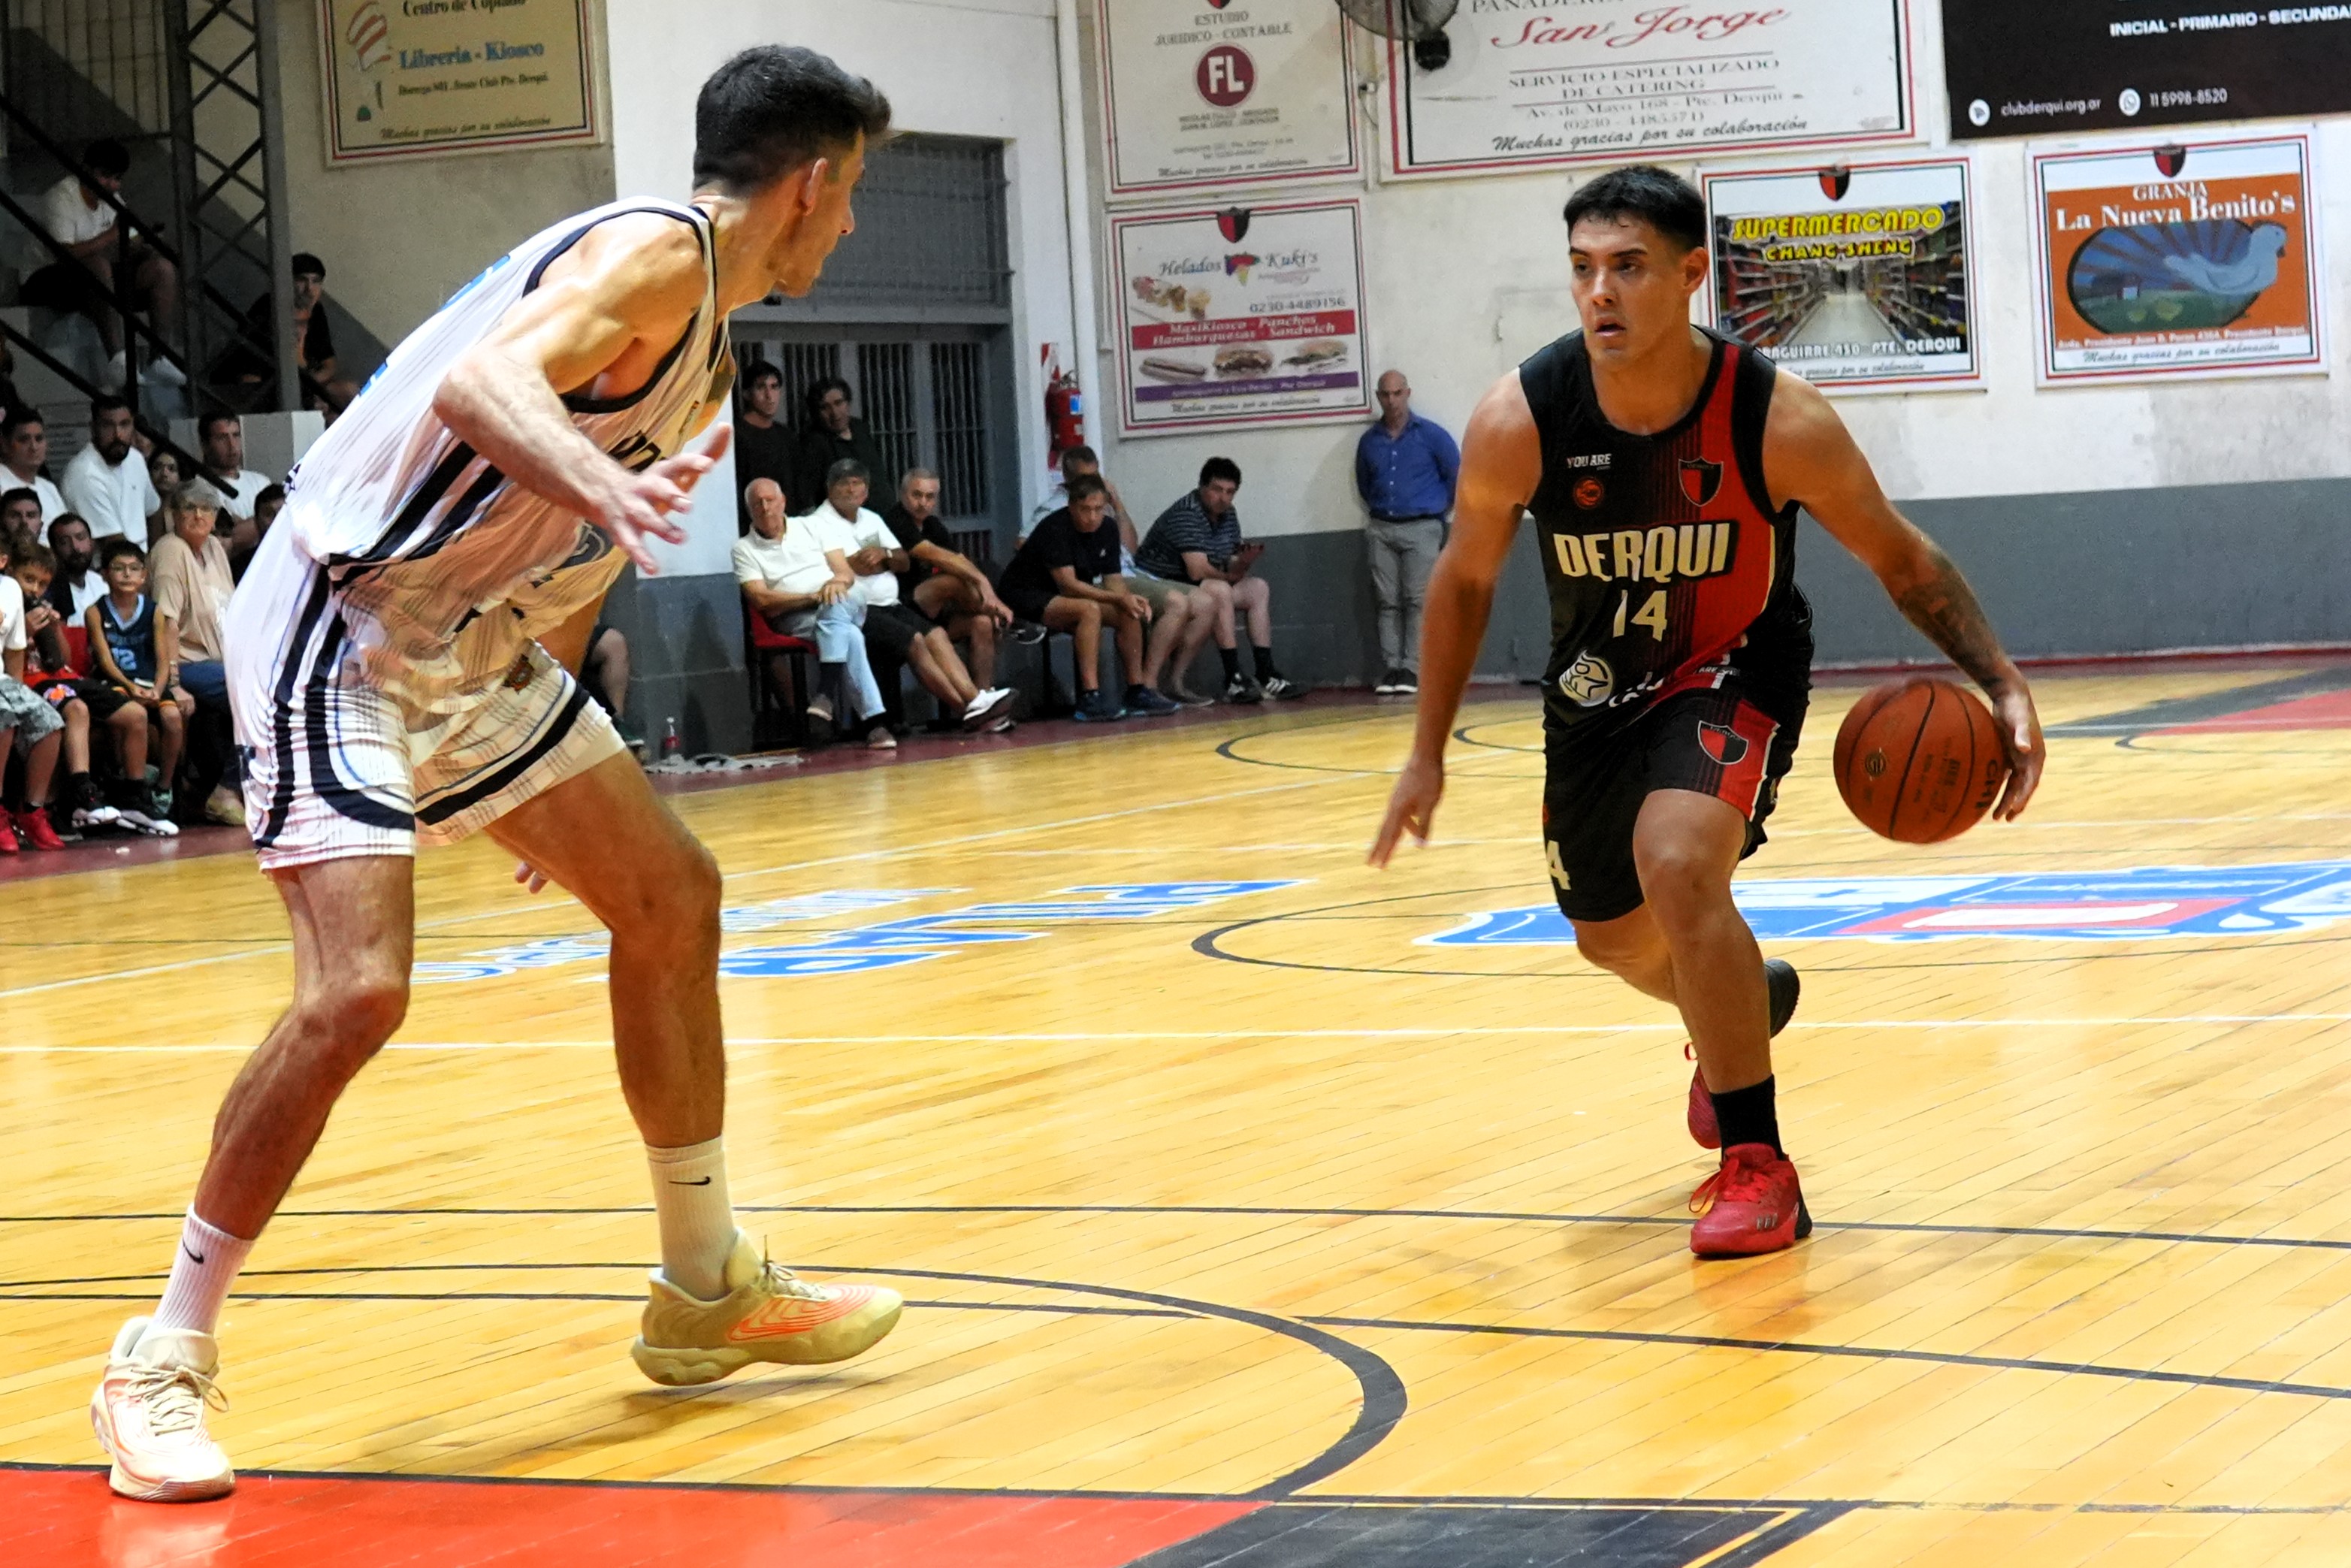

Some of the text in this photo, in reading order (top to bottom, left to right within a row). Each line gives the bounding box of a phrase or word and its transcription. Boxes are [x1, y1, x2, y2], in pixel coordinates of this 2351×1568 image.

[1195, 11, 1249, 26] ESTUDIO
[1222, 23, 1292, 38] CONTABLE
[1491, 5, 1791, 48] San Jorge
[2109, 19, 2168, 37] INICIAL
[2178, 11, 2258, 32] PRIMARIO
[2268, 4, 2351, 25] SECUNDA
[1207, 55, 1245, 94] FL
[1509, 59, 1779, 87] SERVICIO ESPECIALIZADO
[1563, 79, 1705, 99] DE CATERING
[2001, 88, 2228, 116] clubderqui.org.ar 11 5998-8520
[1586, 102, 1632, 113] Mayo
[1724, 92, 1782, 104] Derqui
[1491, 115, 1808, 151] Muchas gracias por su colaboración
[2132, 181, 2207, 201] GRANJA
[1732, 205, 1943, 241] SUPERMERCADO
[2056, 190, 2295, 231] La Nueva Benito's
[1766, 238, 1912, 261] CHANG SHENG
[1159, 256, 1222, 276] Helados
[1153, 331, 1256, 346] Hamburguesas
[1270, 322, 1335, 337] Sandwich
[1259, 316, 1316, 328] Panchos
[1567, 455, 1588, 469] YOU
[1589, 453, 1612, 467] ARE
[1553, 523, 1730, 582] DERQUI
[1612, 588, 1667, 642] 14
